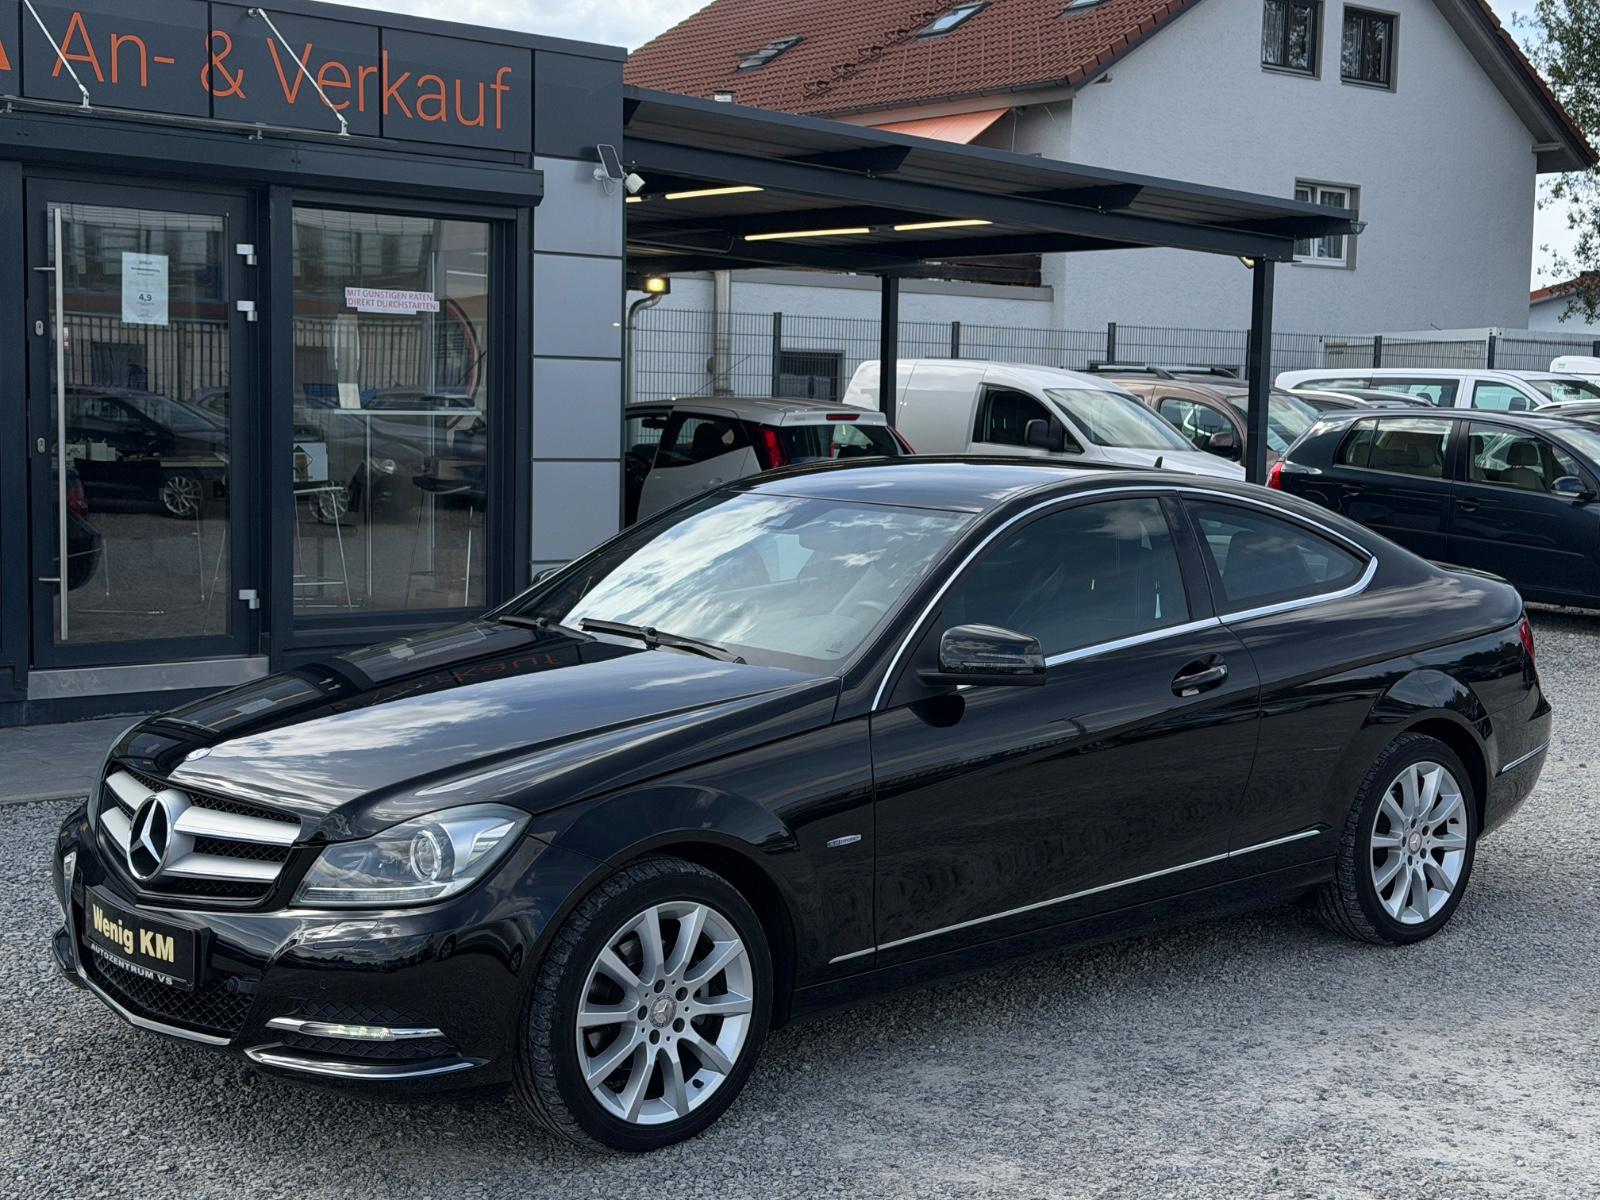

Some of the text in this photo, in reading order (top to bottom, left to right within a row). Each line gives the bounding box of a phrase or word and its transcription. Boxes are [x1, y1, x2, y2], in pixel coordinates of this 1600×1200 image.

[52, 12, 511, 129] An- & Verkauf
[138, 293, 152, 302] 4,9
[346, 289, 361, 297] MIT
[408, 293, 433, 301] RATEN
[348, 297, 376, 307] DIREKT
[92, 903, 175, 963] Wenig KM
[90, 943, 154, 980] AUTOZENTRUM
